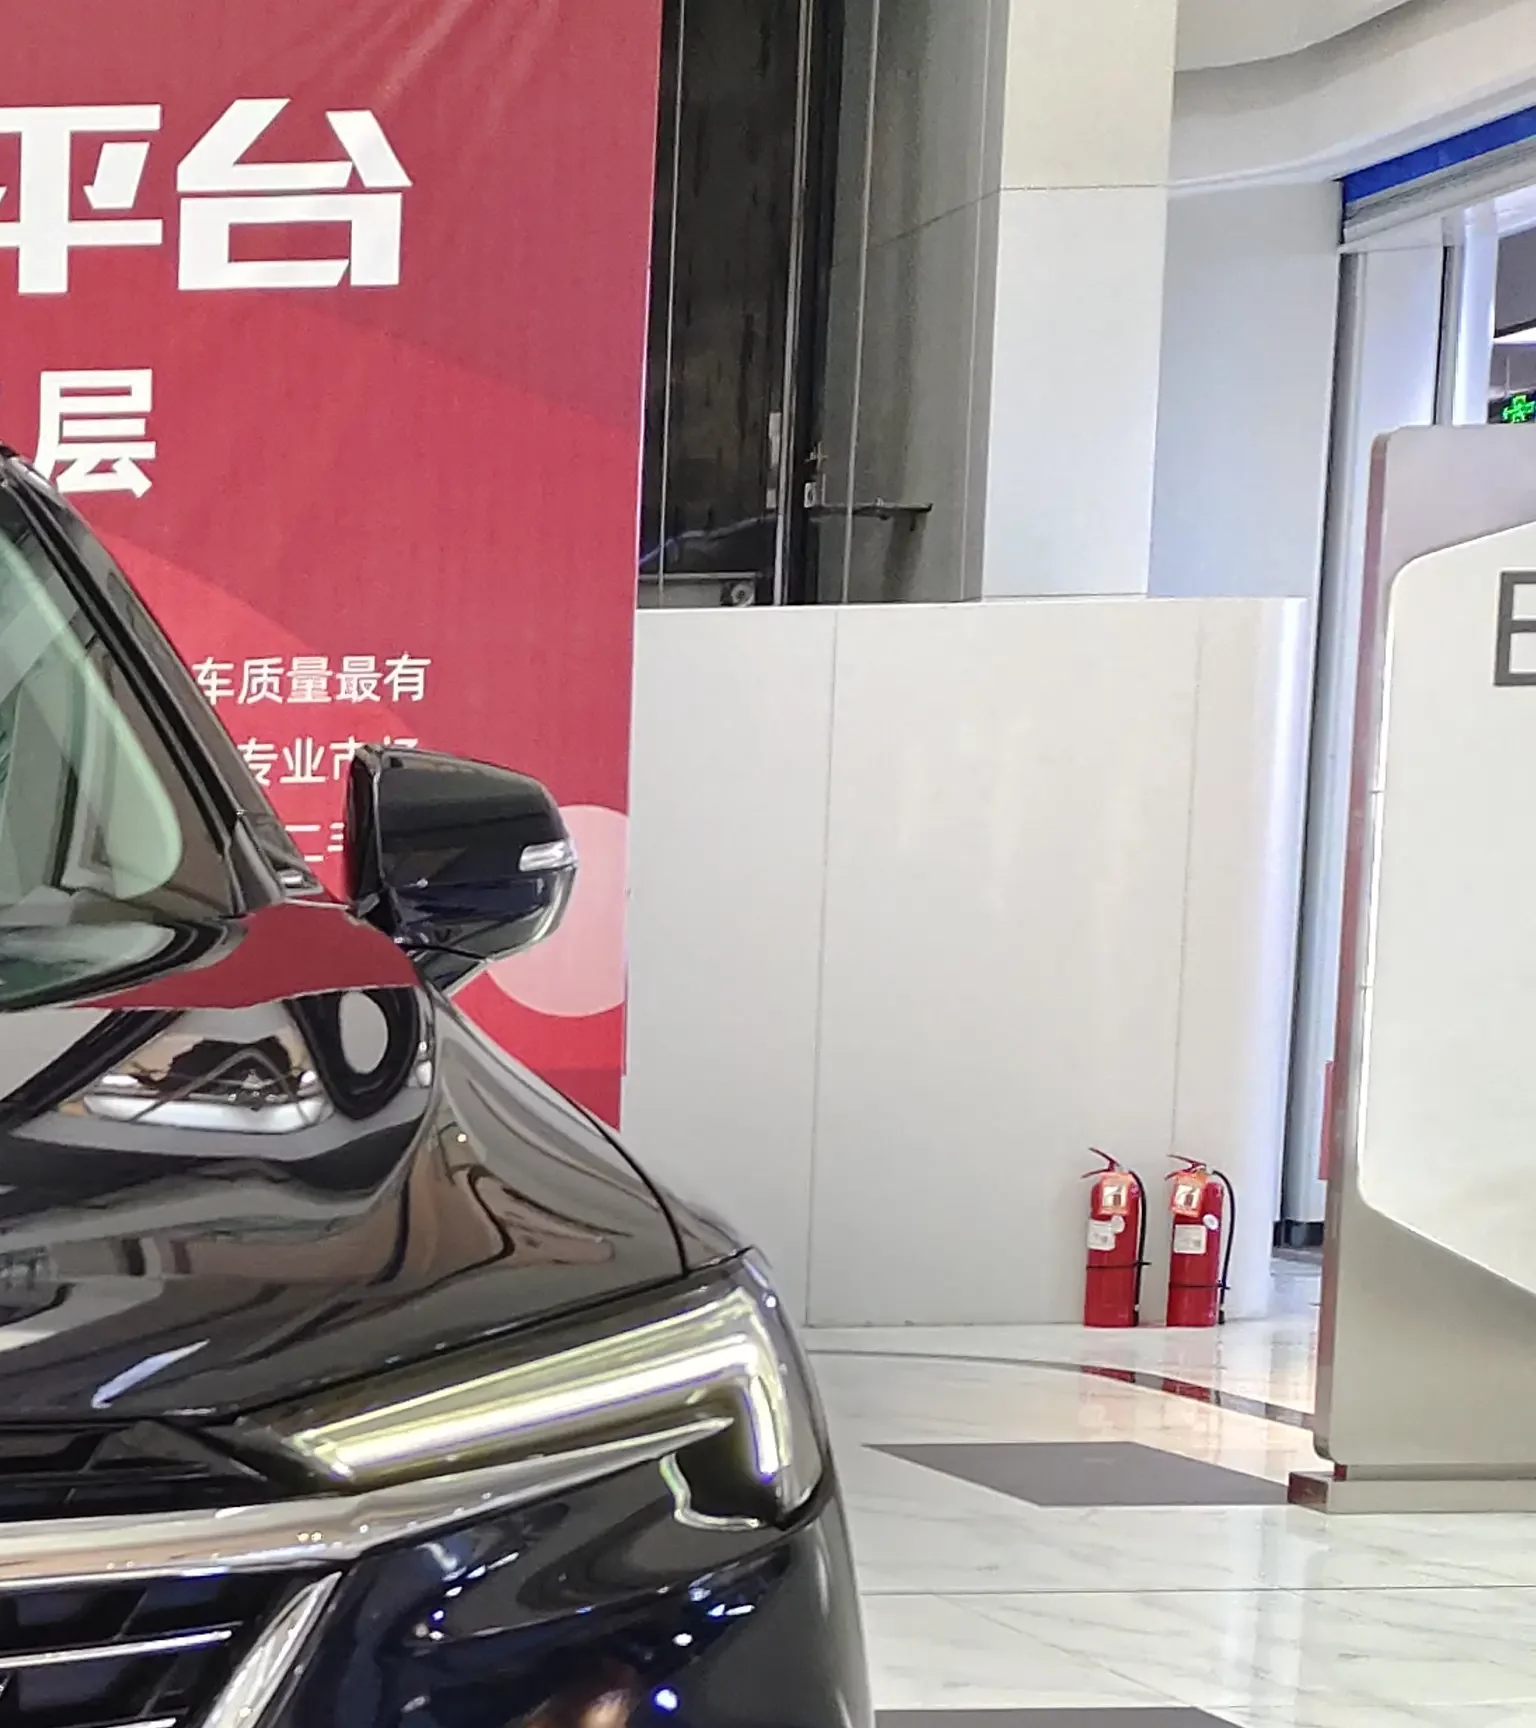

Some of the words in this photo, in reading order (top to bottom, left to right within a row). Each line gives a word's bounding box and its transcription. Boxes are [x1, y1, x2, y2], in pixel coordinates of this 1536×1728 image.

[191, 652, 432, 705] 车质量最有
[237, 736, 419, 786] 专业
